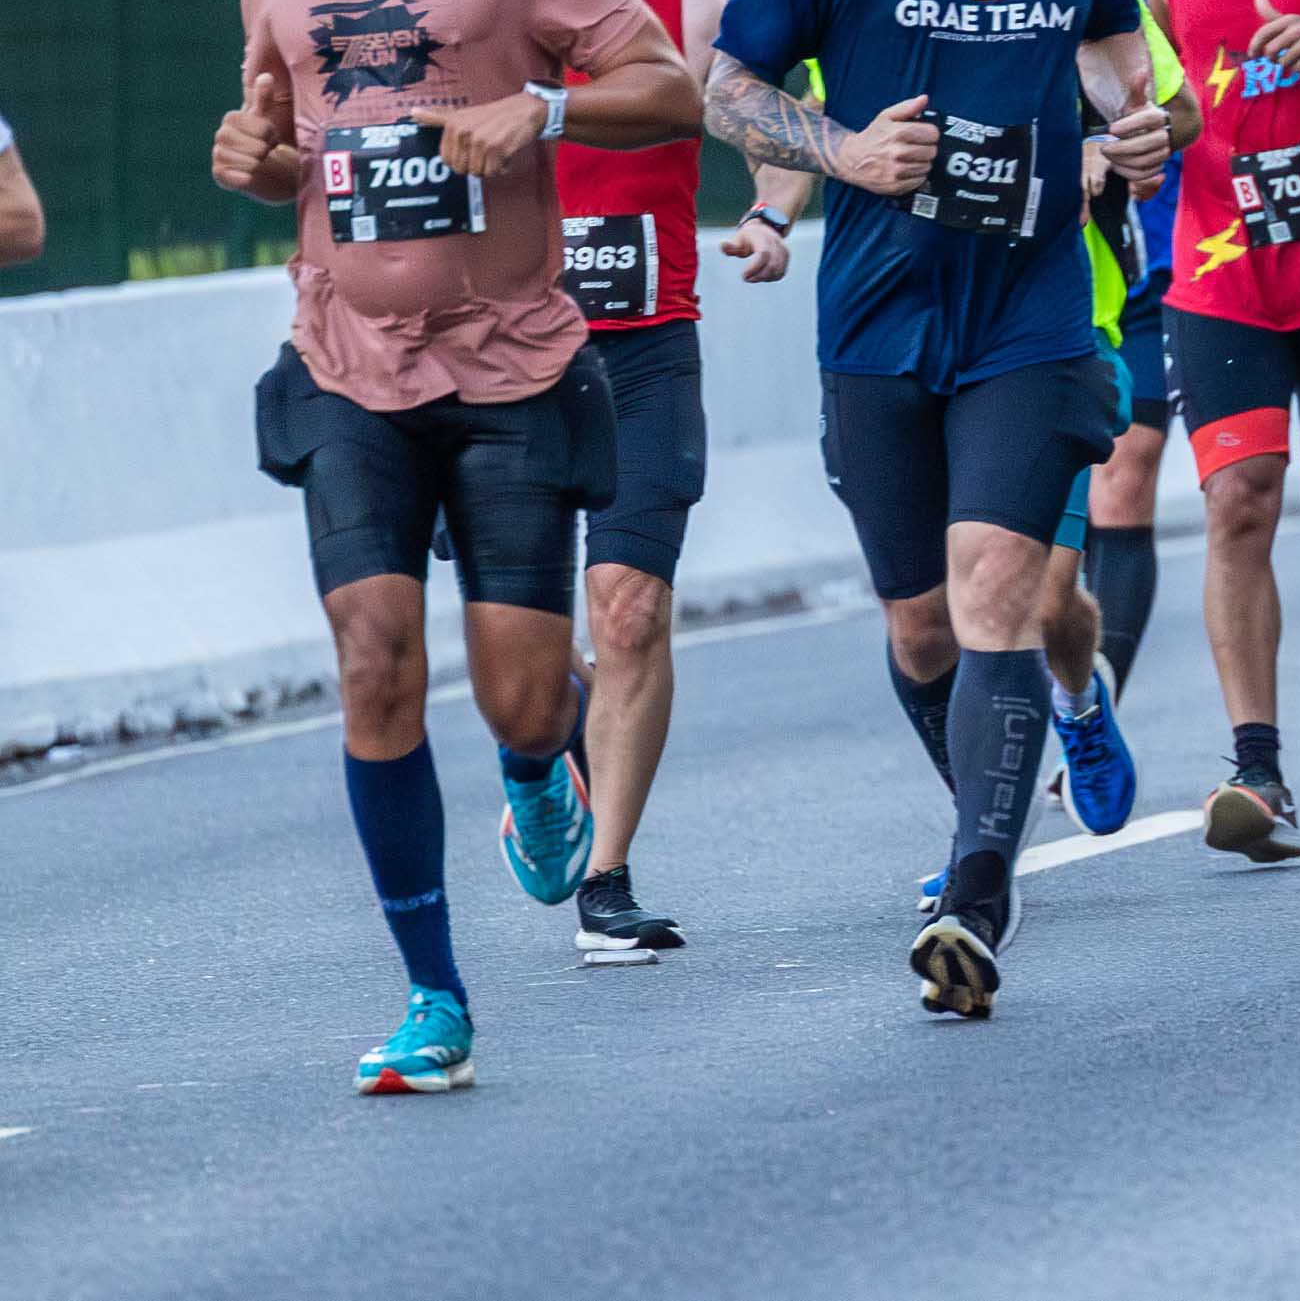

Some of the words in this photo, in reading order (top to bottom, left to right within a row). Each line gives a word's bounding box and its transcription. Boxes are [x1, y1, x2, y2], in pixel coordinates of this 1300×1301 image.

[895, 0, 980, 32] GRAE
[984, 1, 1076, 32] TEAM
[331, 159, 344, 187] B
[369, 156, 450, 188] 7100
[946, 151, 1018, 184] 6311
[1239, 181, 1254, 204] B
[978, 695, 1041, 839] Kalenji
